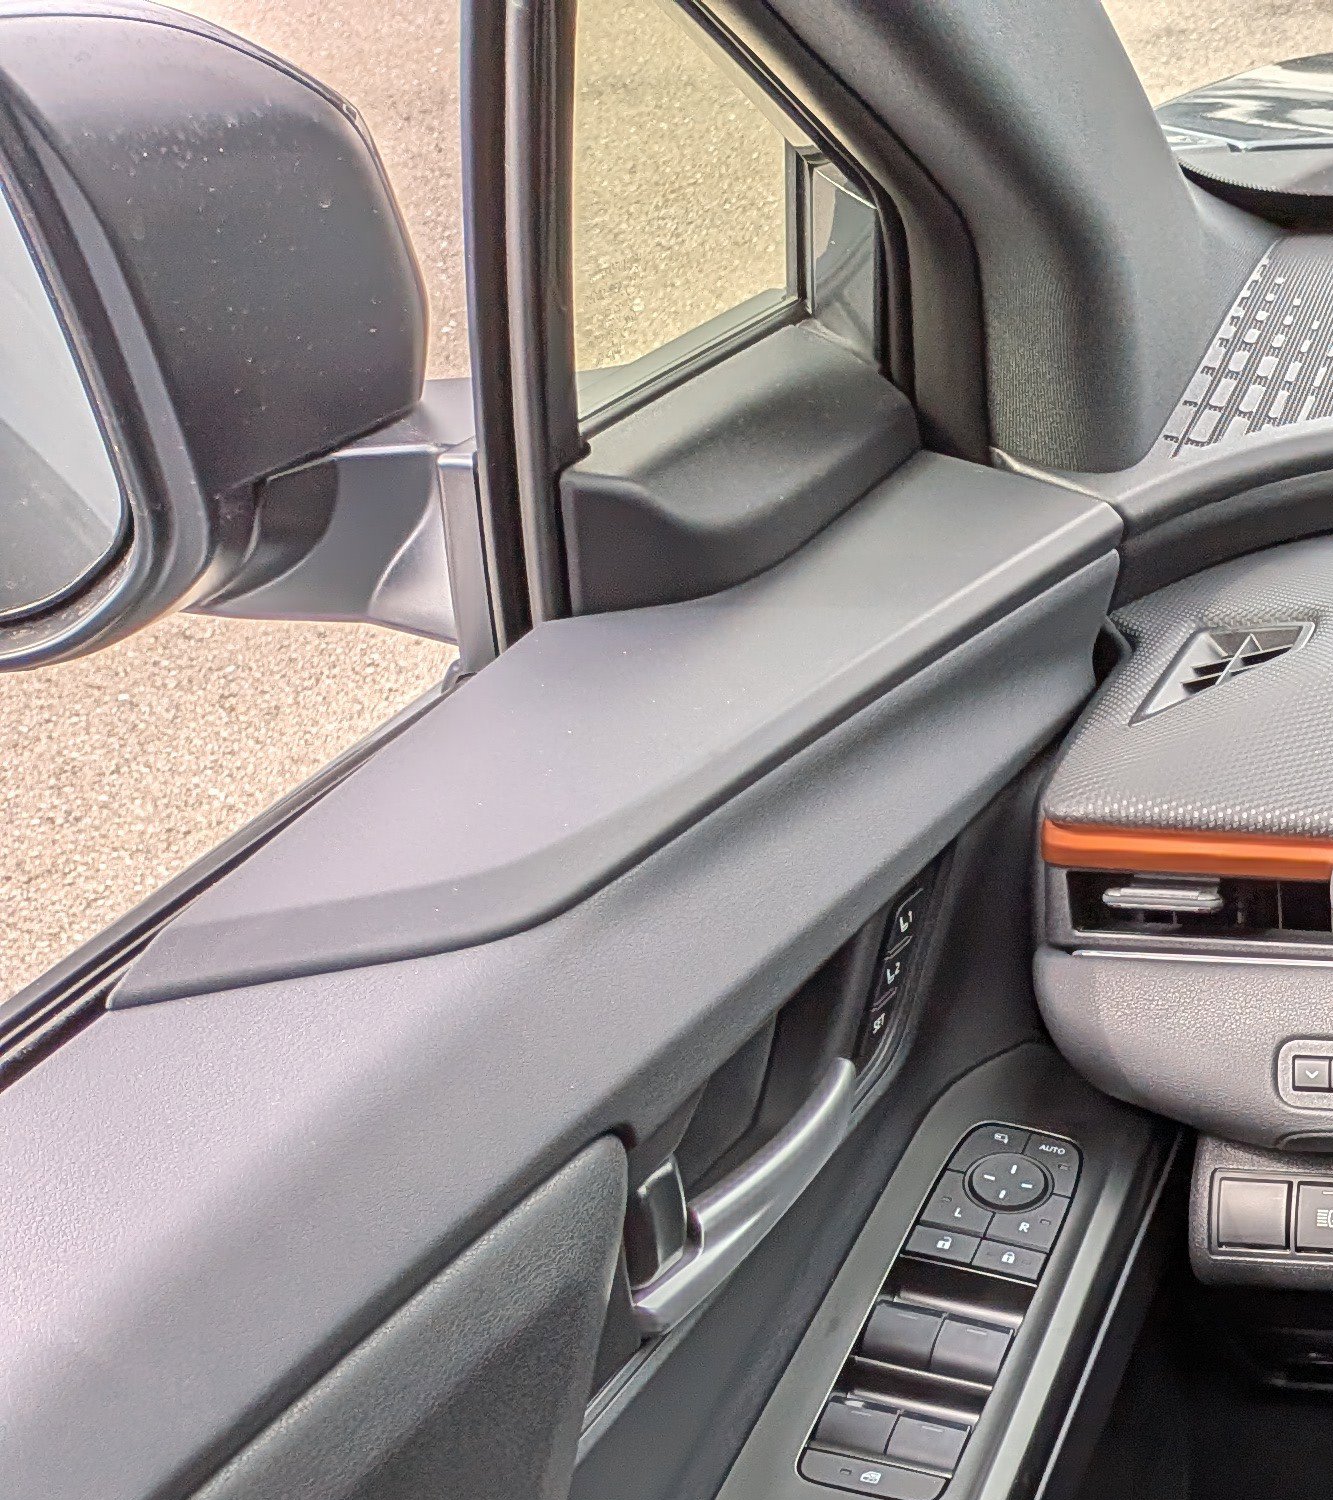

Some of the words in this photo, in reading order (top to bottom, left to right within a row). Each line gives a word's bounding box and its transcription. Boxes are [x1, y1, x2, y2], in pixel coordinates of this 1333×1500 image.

[1039, 1144, 1066, 1155] AUTO
[954, 1207, 962, 1218] L
[1018, 1221, 1030, 1233] R
